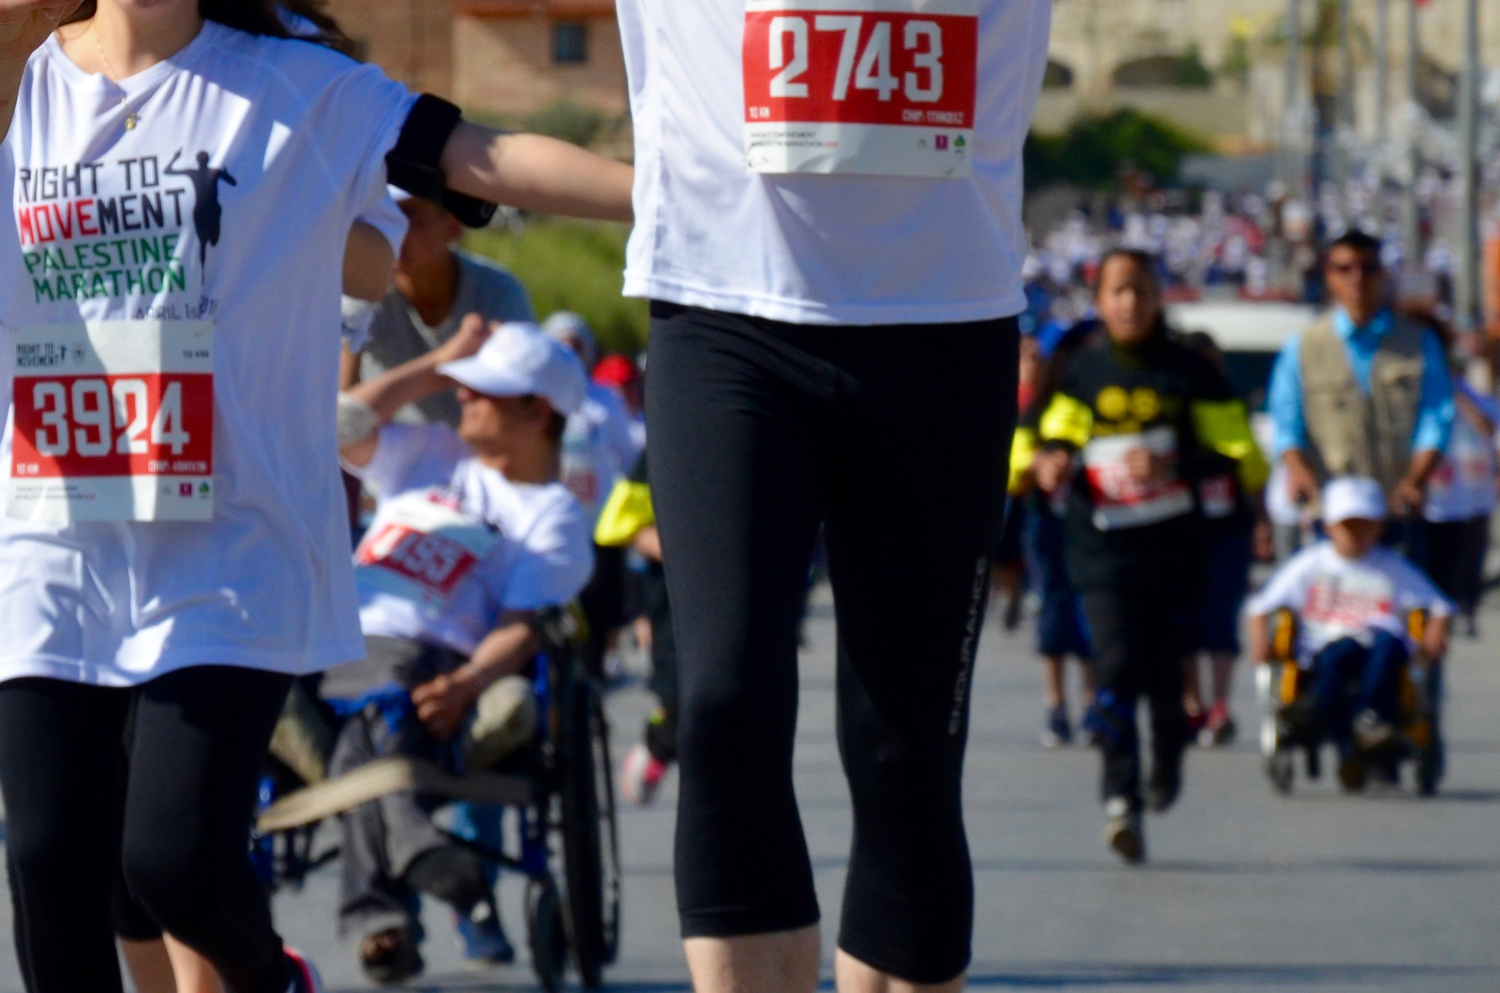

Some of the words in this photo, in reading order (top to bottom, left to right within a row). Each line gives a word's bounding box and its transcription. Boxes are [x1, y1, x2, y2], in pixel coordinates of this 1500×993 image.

[768, 14, 944, 103] 2743
[18, 163, 104, 204] RIGHT
[117, 155, 160, 191] TO
[17, 188, 186, 246] MOVEMENT
[22, 233, 180, 276] PALESTINE
[32, 264, 186, 304] MARATHON
[33, 378, 191, 458] 3924
